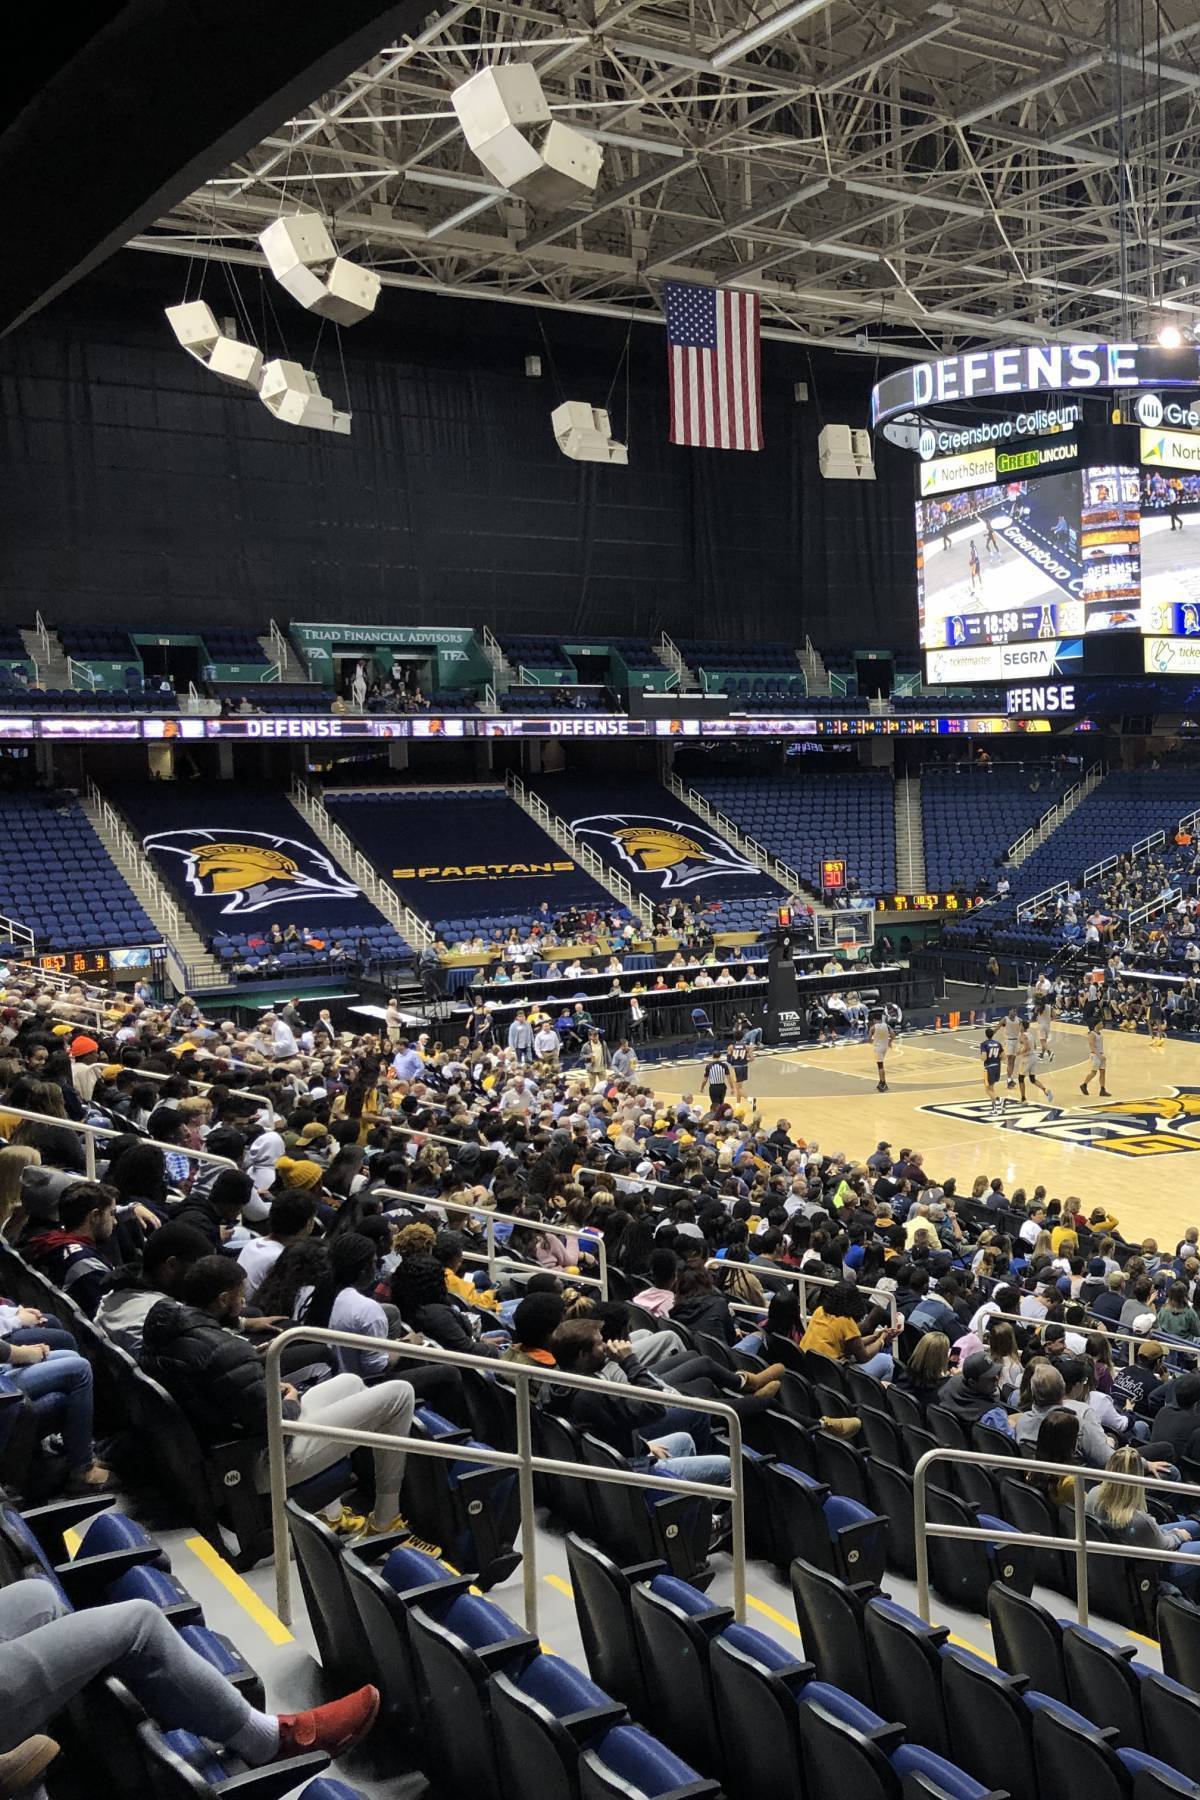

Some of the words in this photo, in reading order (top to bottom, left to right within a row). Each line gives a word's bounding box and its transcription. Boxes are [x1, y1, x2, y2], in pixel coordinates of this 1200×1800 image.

[913, 344, 1140, 405] DEFENSE
[938, 420, 1012, 451] Greensboro
[1015, 405, 1080, 434] Coliseum
[1040, 444, 1078, 464] LINCOLN
[941, 459, 995, 482] NorthState
[1003, 526, 1071, 580] Greensboro
[983, 611, 1019, 635] 18:58
[302, 629, 341, 641] TRIAD
[344, 630, 406, 642] FINANCIAL
[409, 632, 463, 643] ADVISORS
[440, 650, 470, 661] TFA
[949, 655, 992, 667] ticketmaster
[1003, 650, 1048, 666] SEGRA
[248, 720, 343, 737] DEFENSE
[550, 720, 629, 735] DEFENSE
[977, 721, 993, 733] 31
[392, 861, 575, 878] SPARTANS
[825, 871, 841, 886] 30
[778, 1011, 800, 1021] TFA
[732, 1050, 746, 1060] 44
[988, 1047, 1000, 1058] 14
